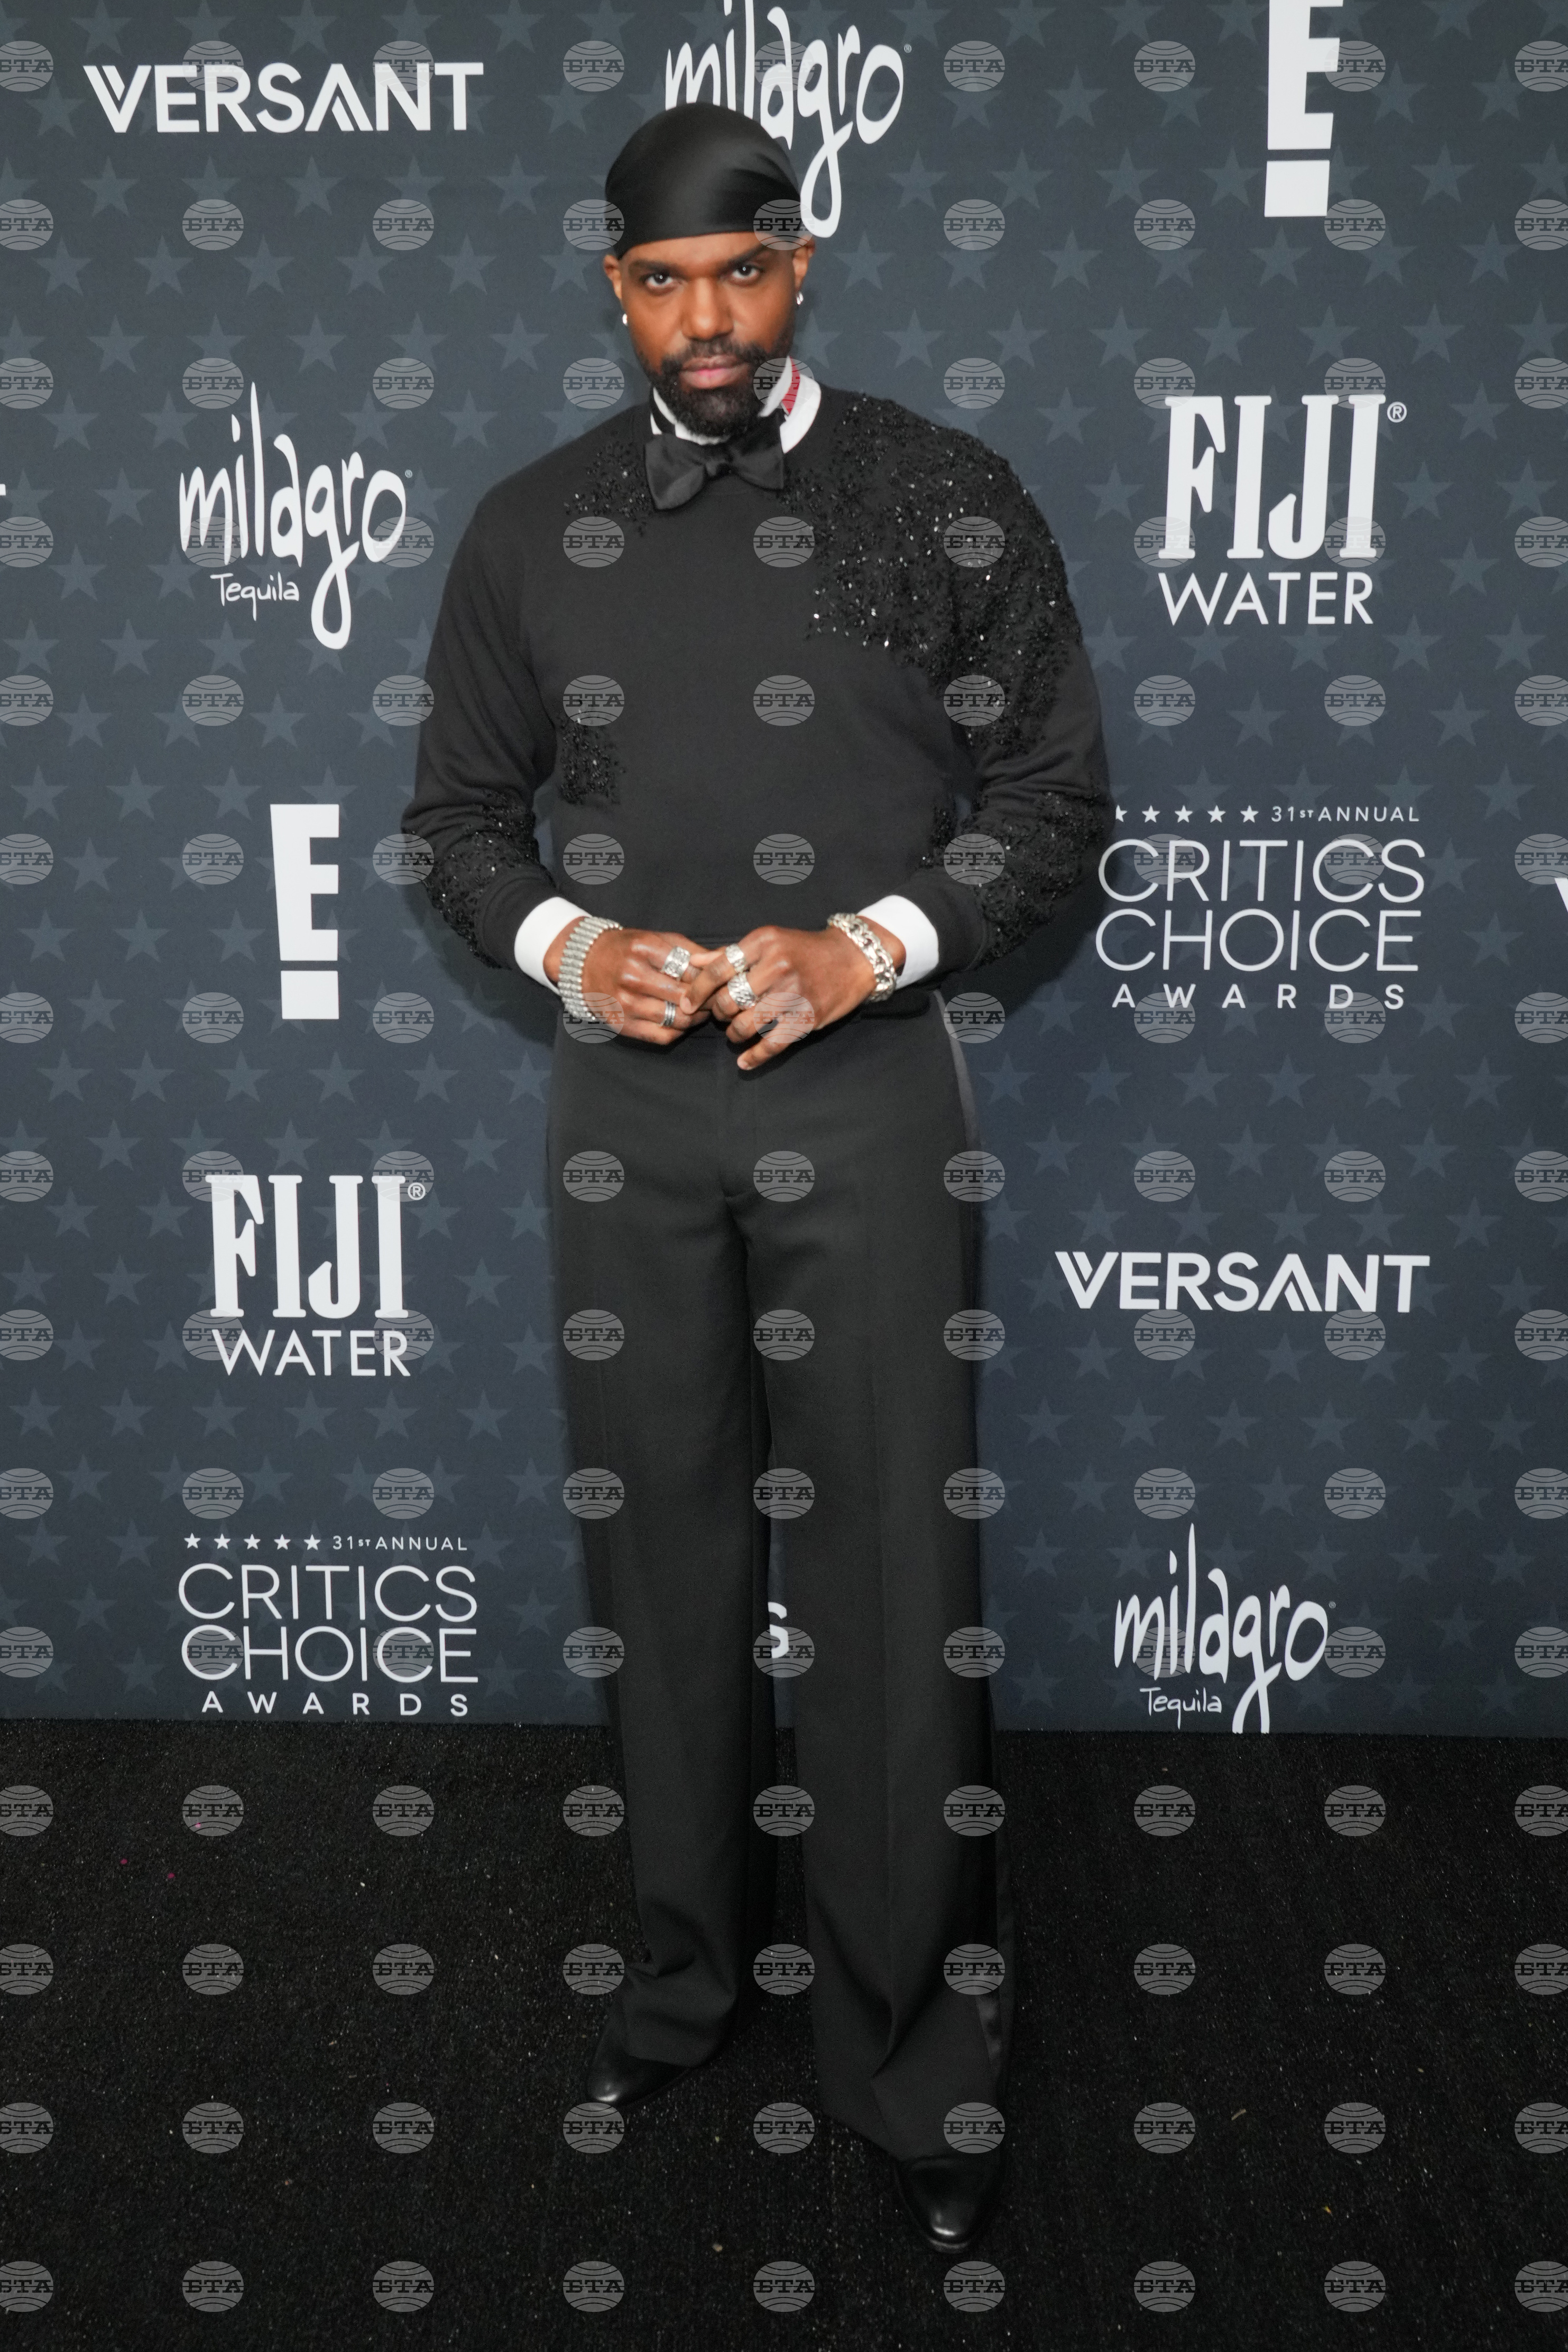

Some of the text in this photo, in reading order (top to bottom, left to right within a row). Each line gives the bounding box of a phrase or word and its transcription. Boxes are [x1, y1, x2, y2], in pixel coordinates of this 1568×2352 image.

[84, 63, 483, 133] VERSANT
[180, 382, 405, 650] milagro
[210, 572, 300, 621] Tequila
[1158, 571, 1373, 625] WATER
[1318, 806, 1419, 822] ANNUAL
[1099, 838, 1425, 903] CRITICS
[1095, 908, 1422, 972] CHOICE
[1112, 984, 1404, 1010] AWARDS
[1055, 1251, 1431, 1313] VERSANT
[211, 1329, 411, 1376] WATER
[375, 1536, 467, 1550] ANNUAL
[179, 1563, 477, 1622] CRITICS
[181, 1625, 478, 1683] CHOICE
[1114, 1523, 1328, 1733] milagro
[202, 1691, 468, 1717] AWARDS
[1140, 1687, 1222, 1729] Tequila
